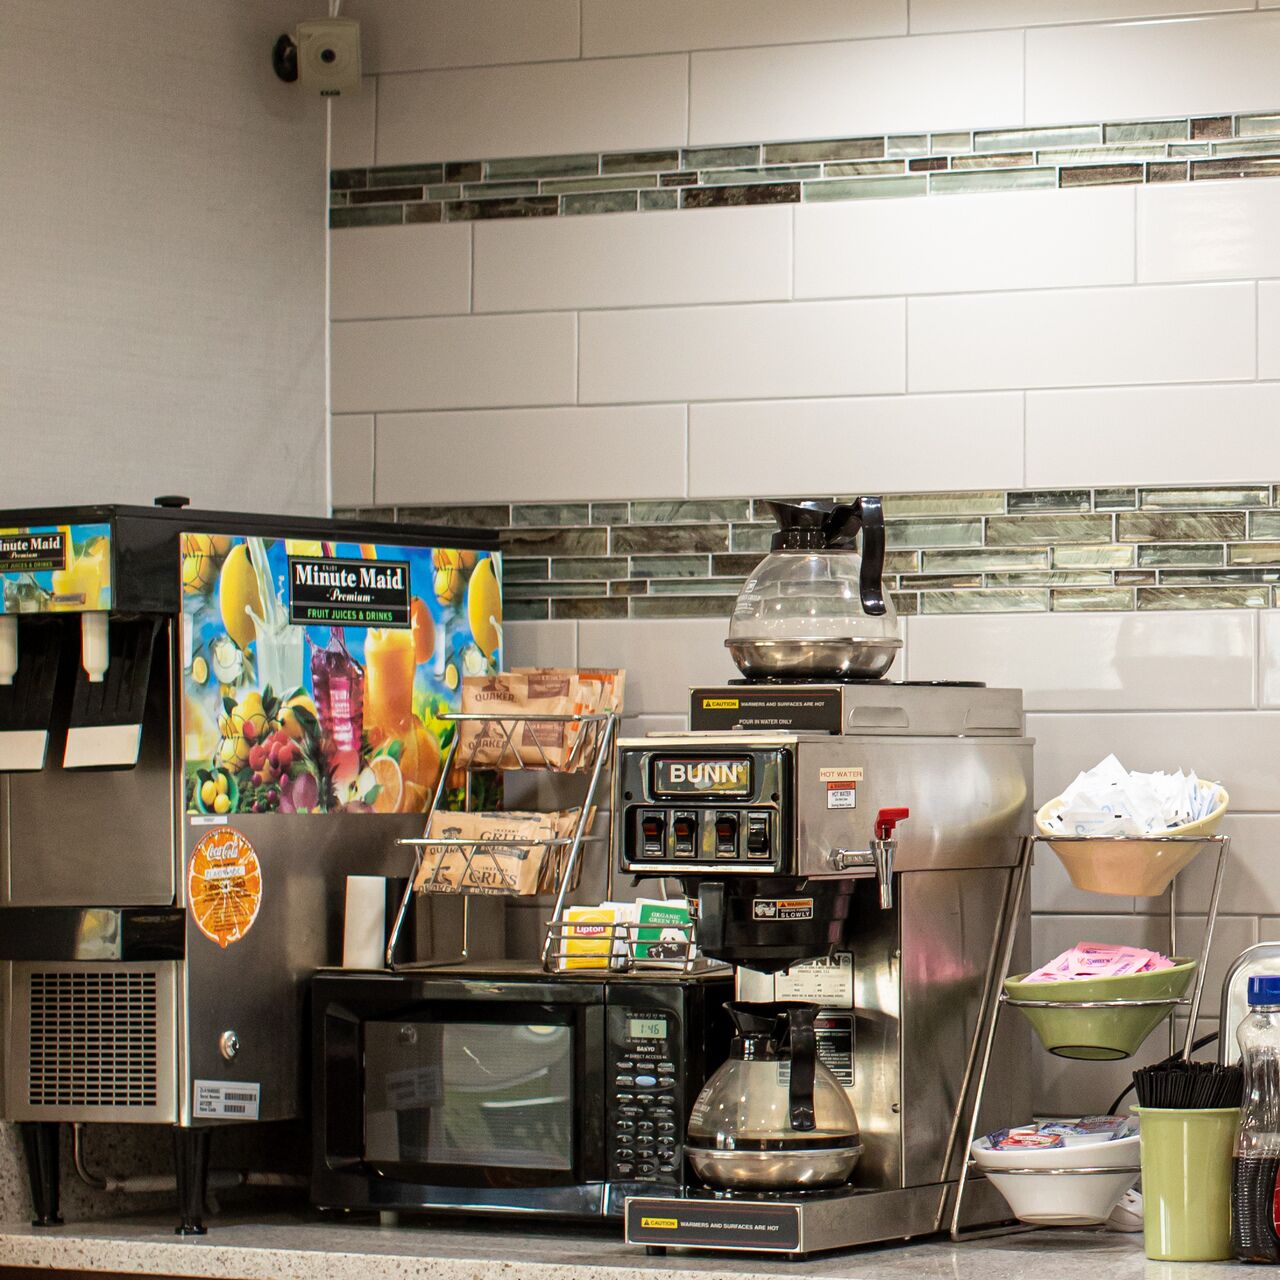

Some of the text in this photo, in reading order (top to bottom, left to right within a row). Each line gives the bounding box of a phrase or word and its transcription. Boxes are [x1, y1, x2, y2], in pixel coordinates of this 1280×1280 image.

[0, 536, 60, 551] inute Maid
[295, 564, 403, 589] Minute Maid
[329, 587, 371, 602] Premium
[307, 608, 393, 621] FRUIT JUICES & DRINKS
[475, 692, 515, 702] QUAKER
[468, 870, 518, 886] GRITS
[651, 911, 680, 920] ORGANIC
[576, 925, 604, 934] Lipton
[641, 1023, 660, 1035] 1:46
